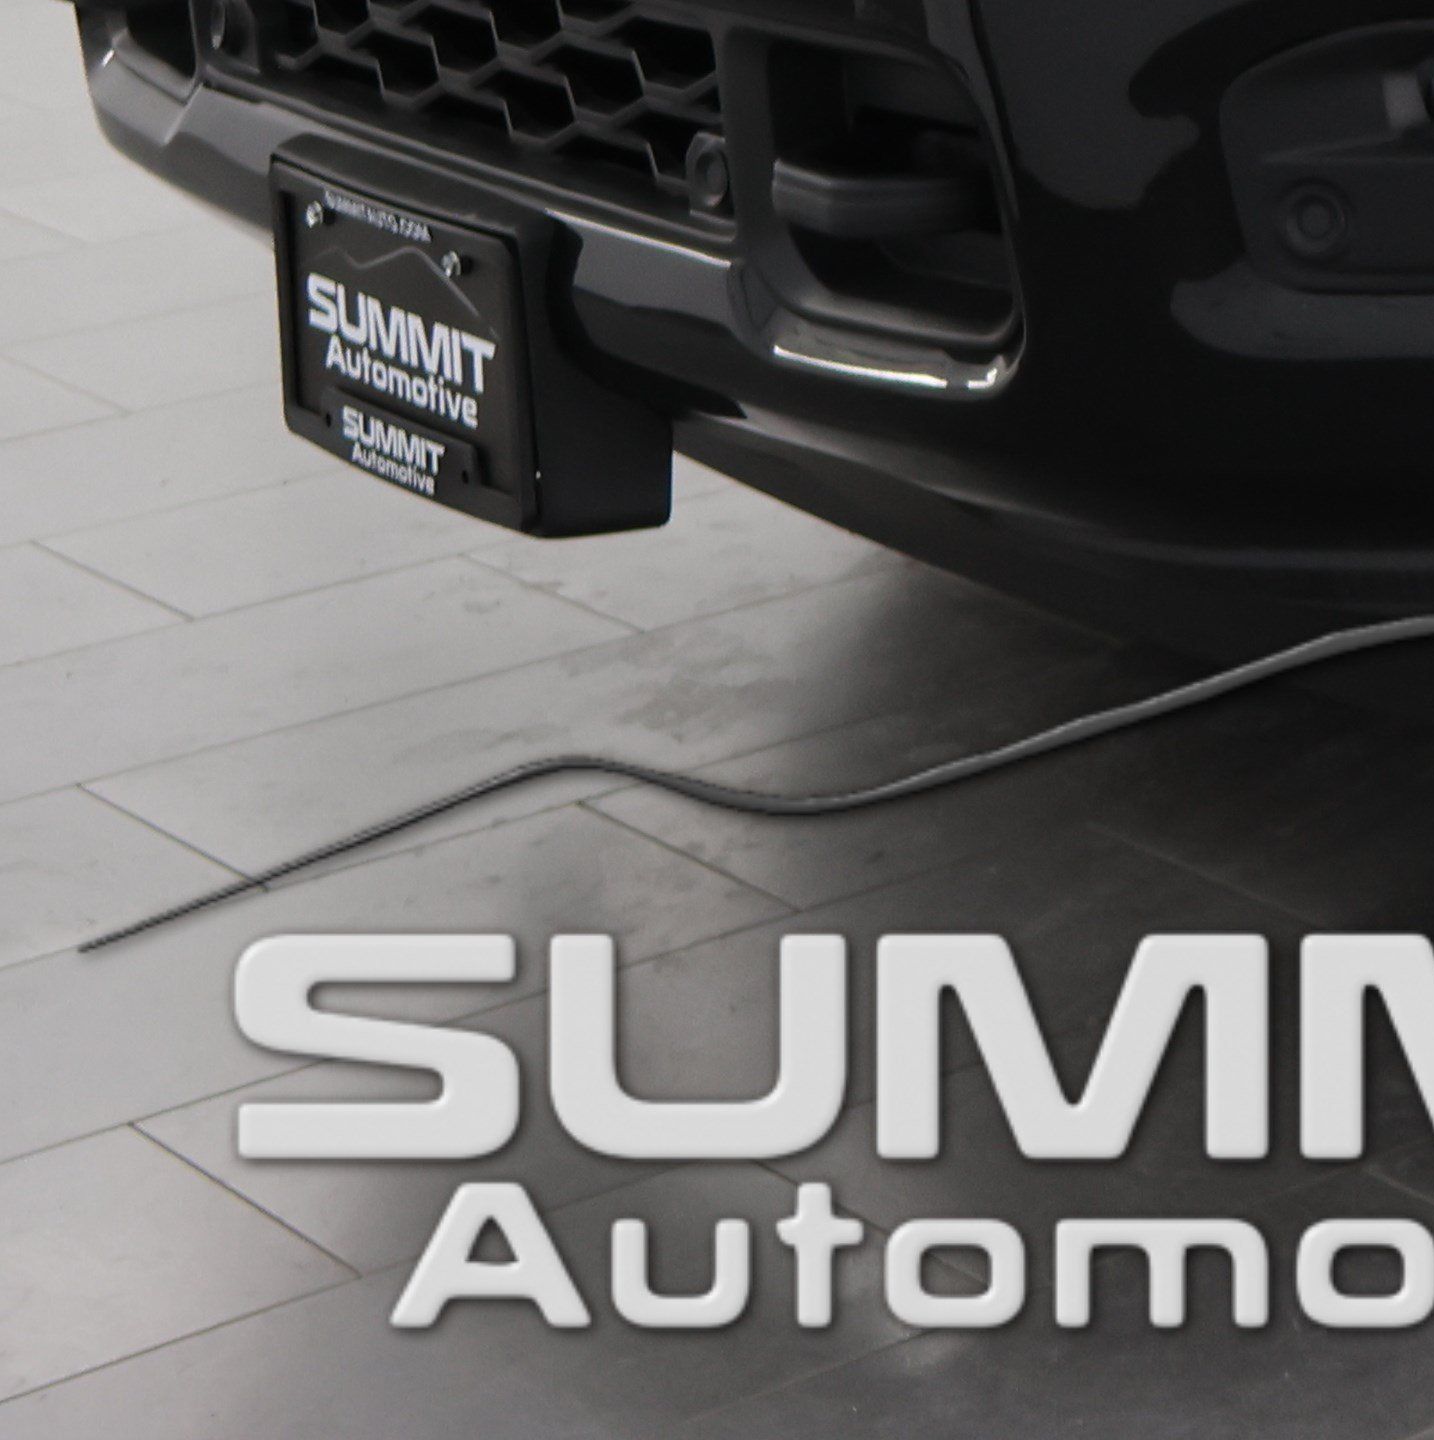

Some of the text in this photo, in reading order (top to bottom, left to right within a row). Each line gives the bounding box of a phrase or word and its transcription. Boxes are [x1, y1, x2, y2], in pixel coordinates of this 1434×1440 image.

[306, 272, 497, 394] SUMMIT
[325, 333, 479, 429] Automotive
[342, 405, 445, 475] SUMMIT
[351, 444, 436, 496] Automotive
